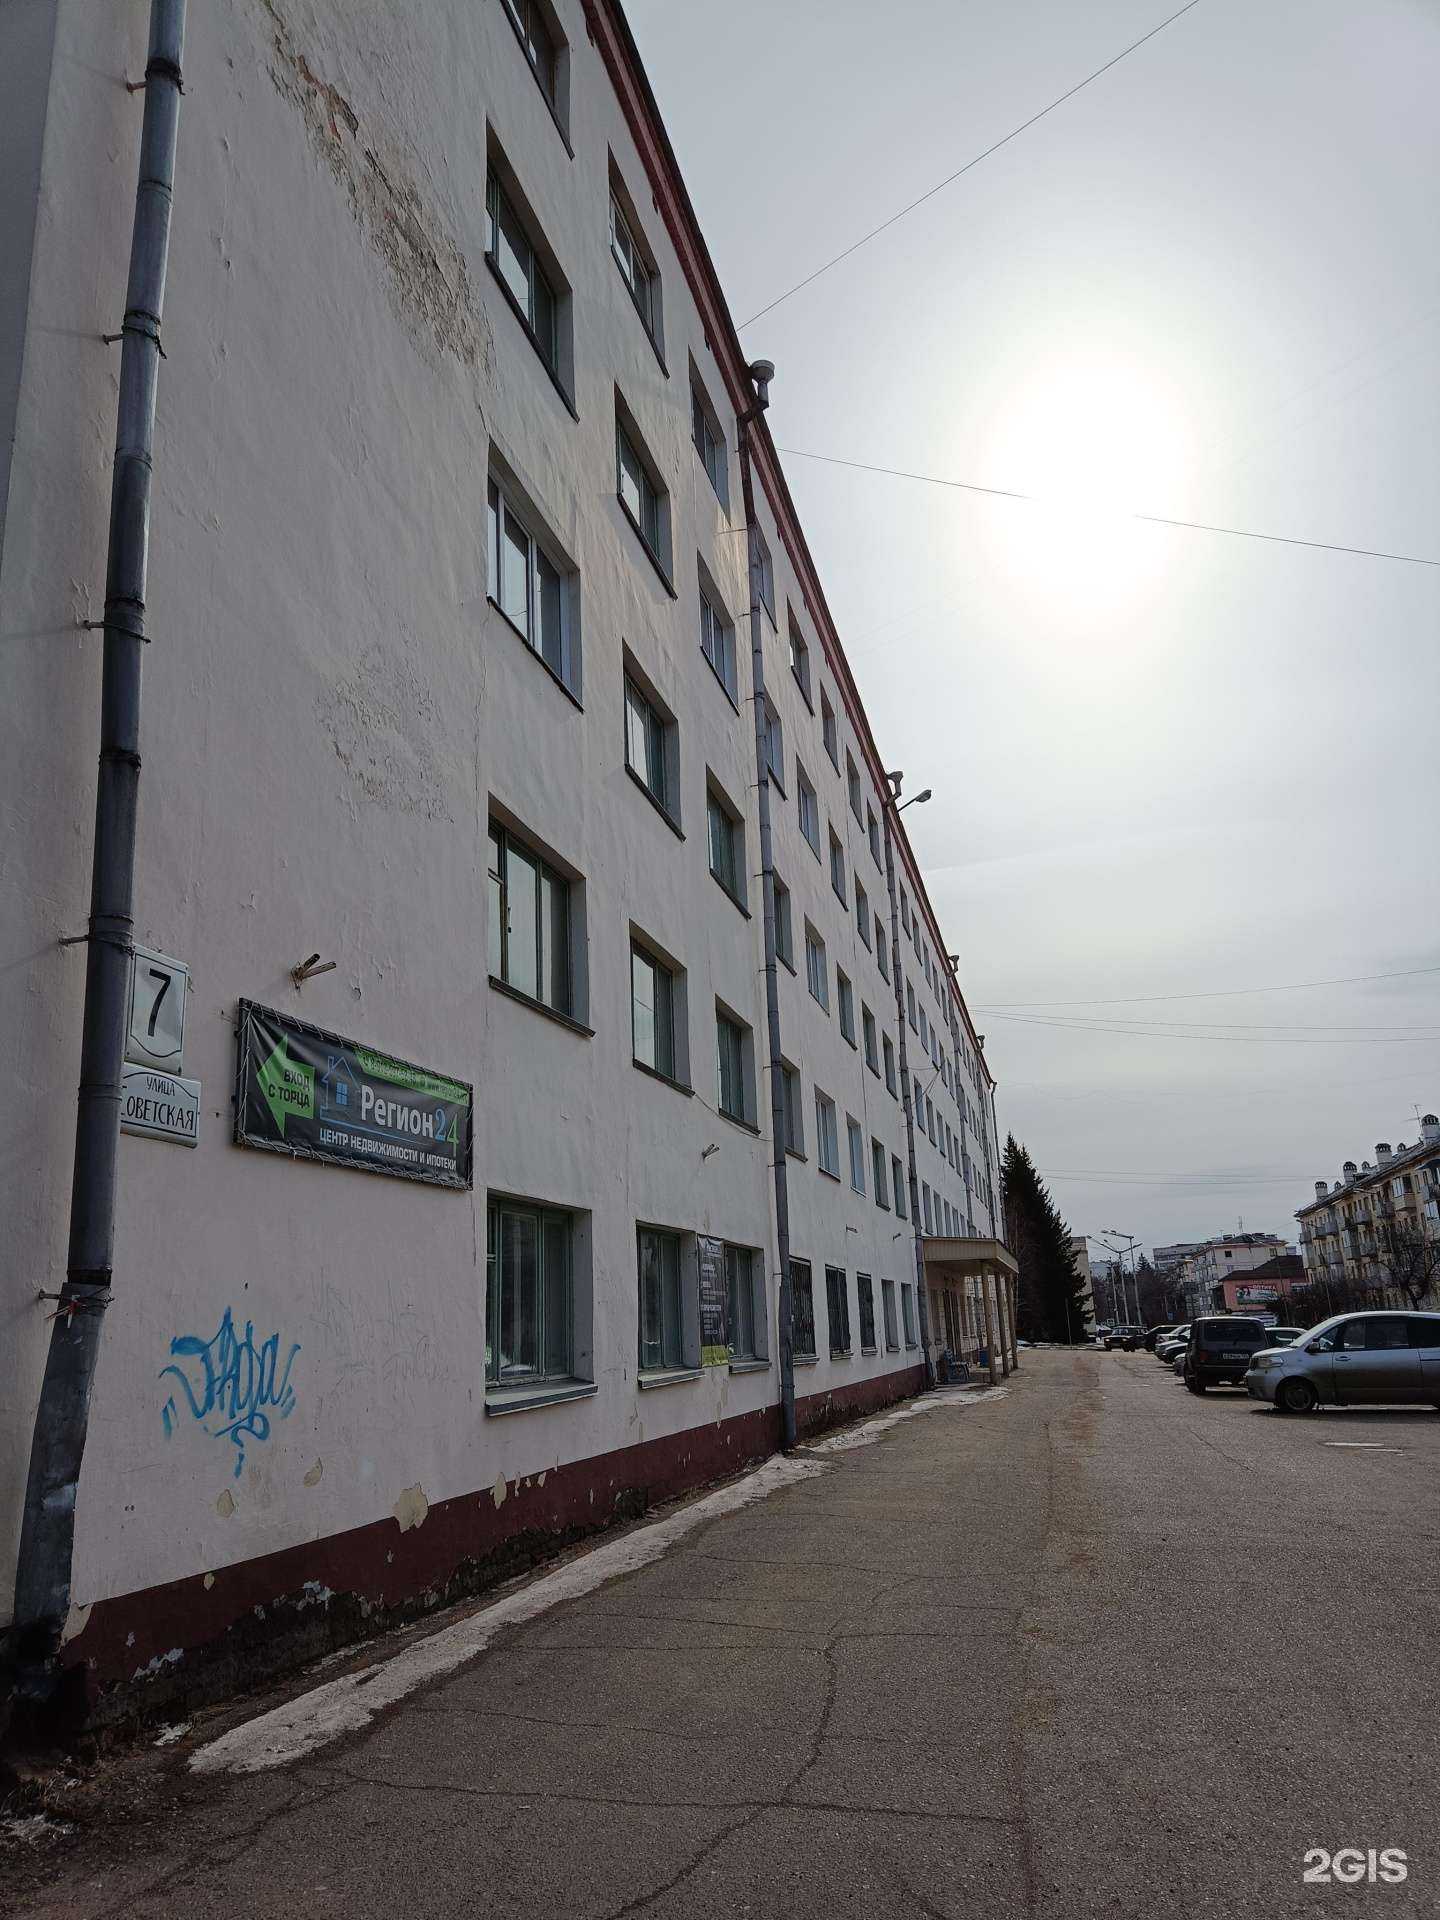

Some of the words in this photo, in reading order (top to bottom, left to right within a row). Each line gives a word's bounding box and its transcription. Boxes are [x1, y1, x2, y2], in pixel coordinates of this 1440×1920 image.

[147, 968, 172, 1037] 7
[146, 1076, 176, 1097] УЛИЦА
[268, 1083, 276, 1098] С
[278, 1086, 310, 1109] ТОРЦА
[283, 1069, 310, 1091] ВХОД
[121, 1095, 196, 1131] ОВЕТСКАЯ
[361, 1084, 459, 1157] Регион24
[319, 1127, 349, 1146] ЦЕНТР
[350, 1135, 418, 1163] НЕДВИЖИМОСТИ
[419, 1153, 425, 1164] И
[426, 1155, 457, 1172] ИПОТЕКИ
